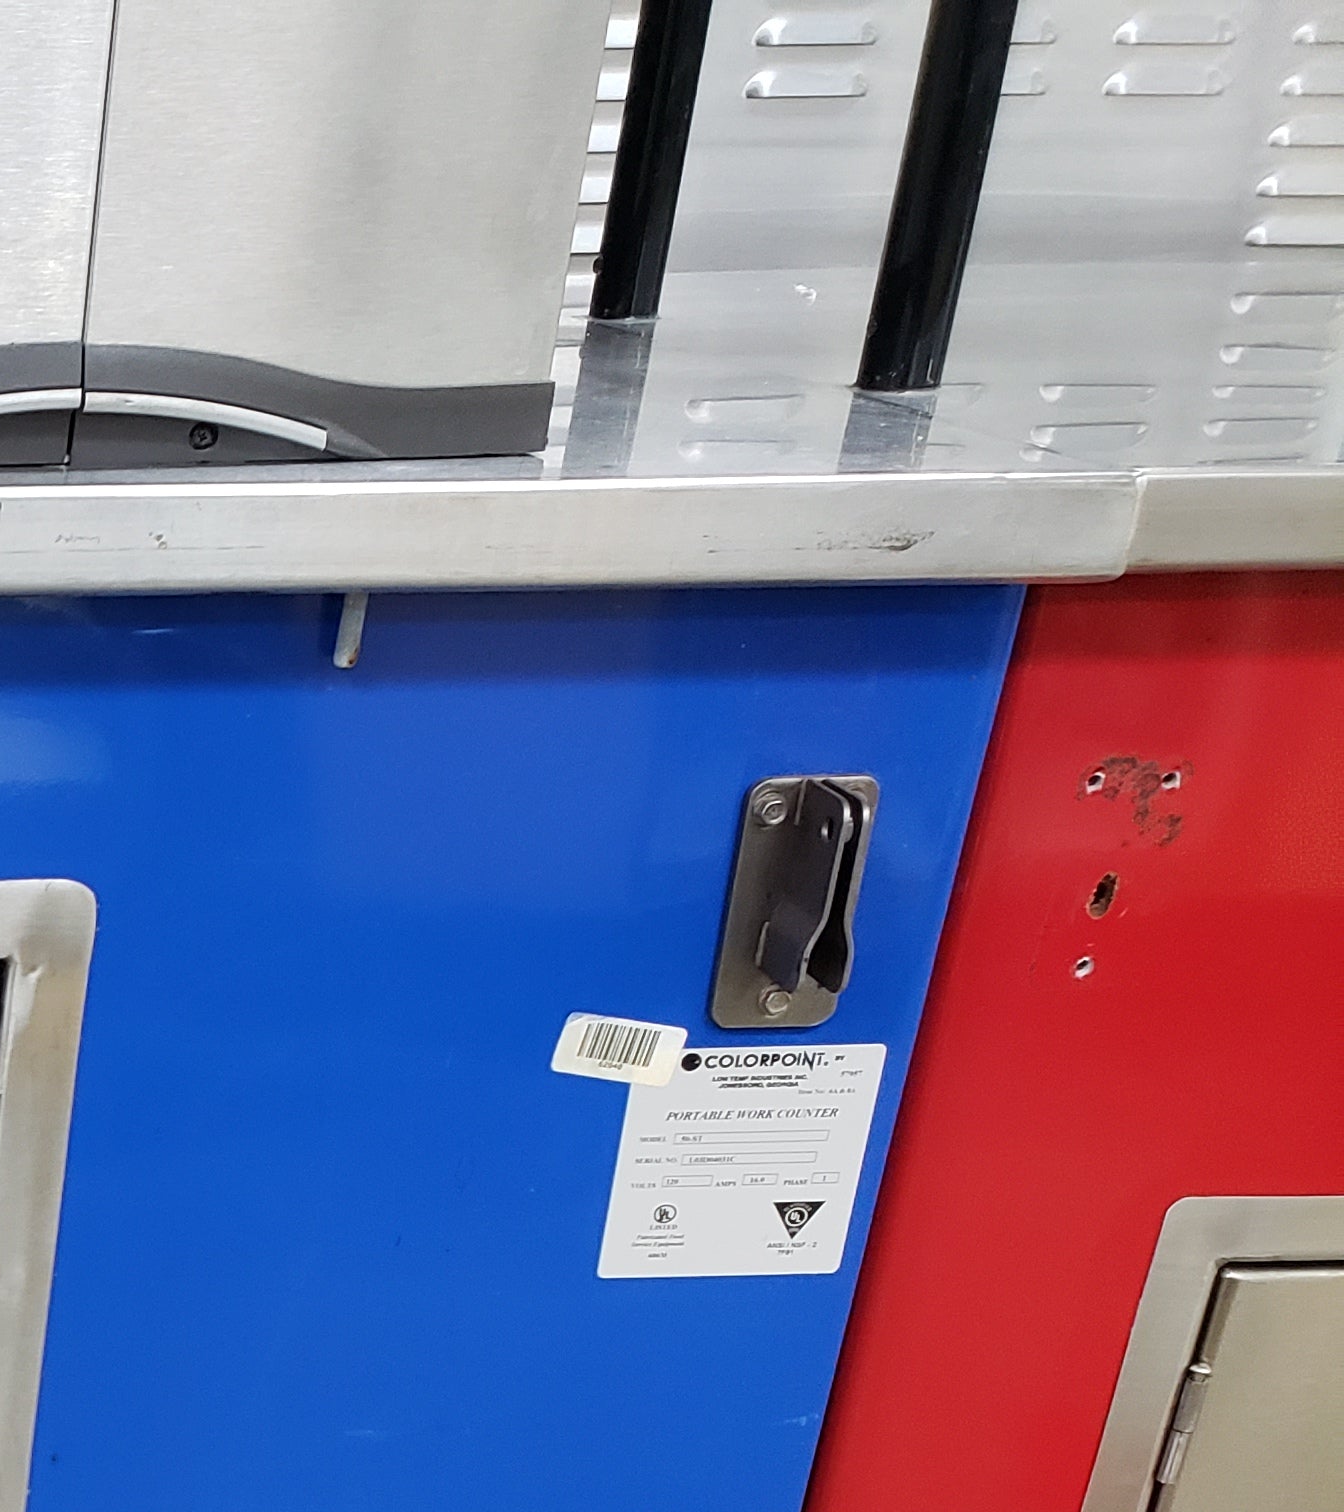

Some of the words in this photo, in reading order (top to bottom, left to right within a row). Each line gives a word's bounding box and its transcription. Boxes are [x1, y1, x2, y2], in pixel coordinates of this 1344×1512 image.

[665, 1110, 735, 1121] PORTABLE
[736, 1109, 775, 1119] WORK
[777, 1108, 839, 1118] COUNTER
